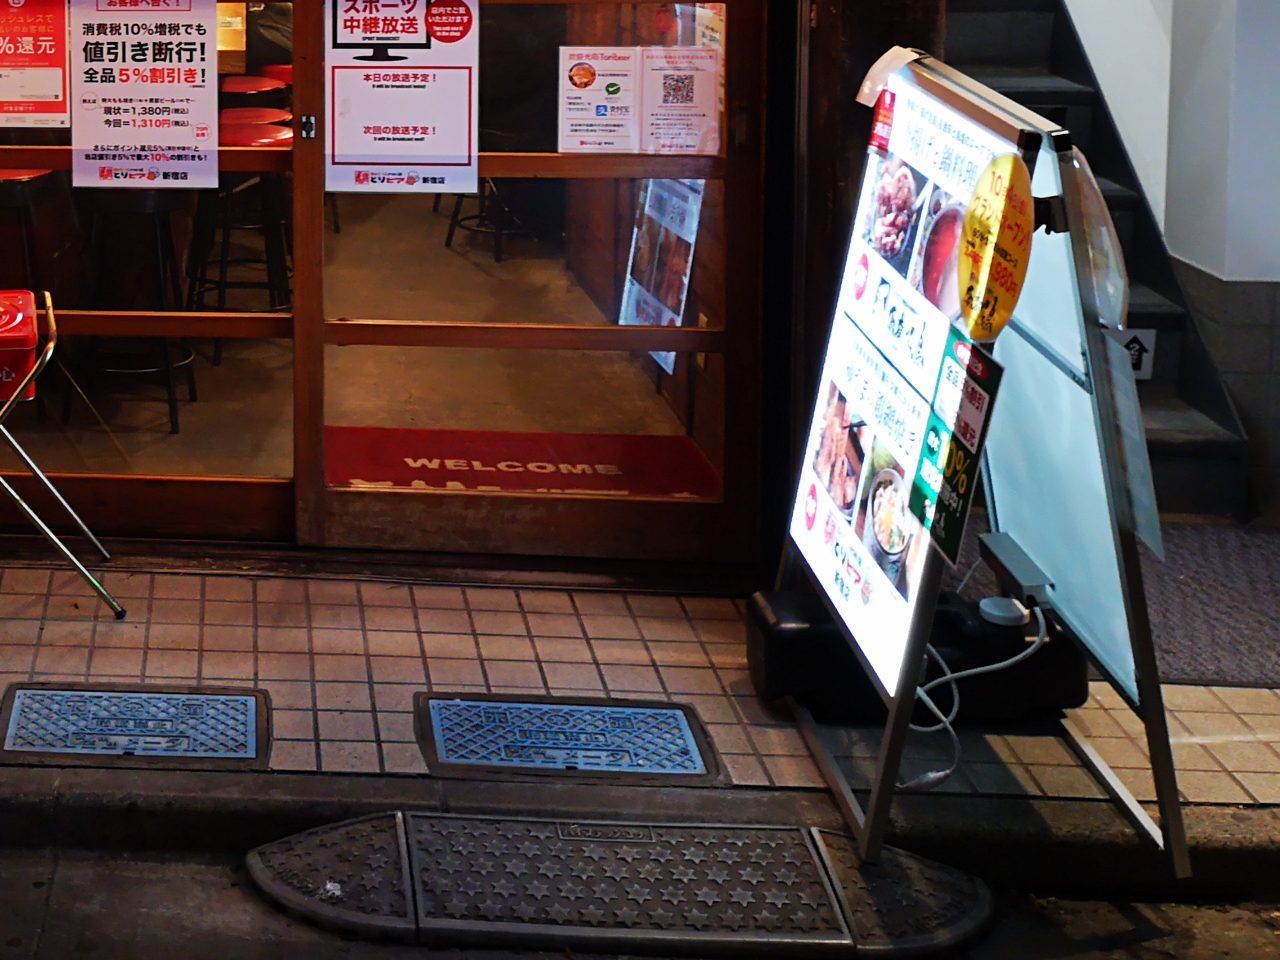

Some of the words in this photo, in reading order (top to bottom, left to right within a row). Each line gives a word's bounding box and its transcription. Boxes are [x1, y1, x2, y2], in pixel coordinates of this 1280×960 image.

[82, 23, 207, 36] 消費税10%増税でも
[343, 17, 418, 34] 中継放送
[82, 41, 206, 63] 値引き断行!
[83, 67, 206, 83] 全品5%割引き!
[363, 73, 436, 83] 本日の放送予定!
[363, 126, 436, 135] 次回の放送予定!
[403, 458, 624, 475] WELCOME
